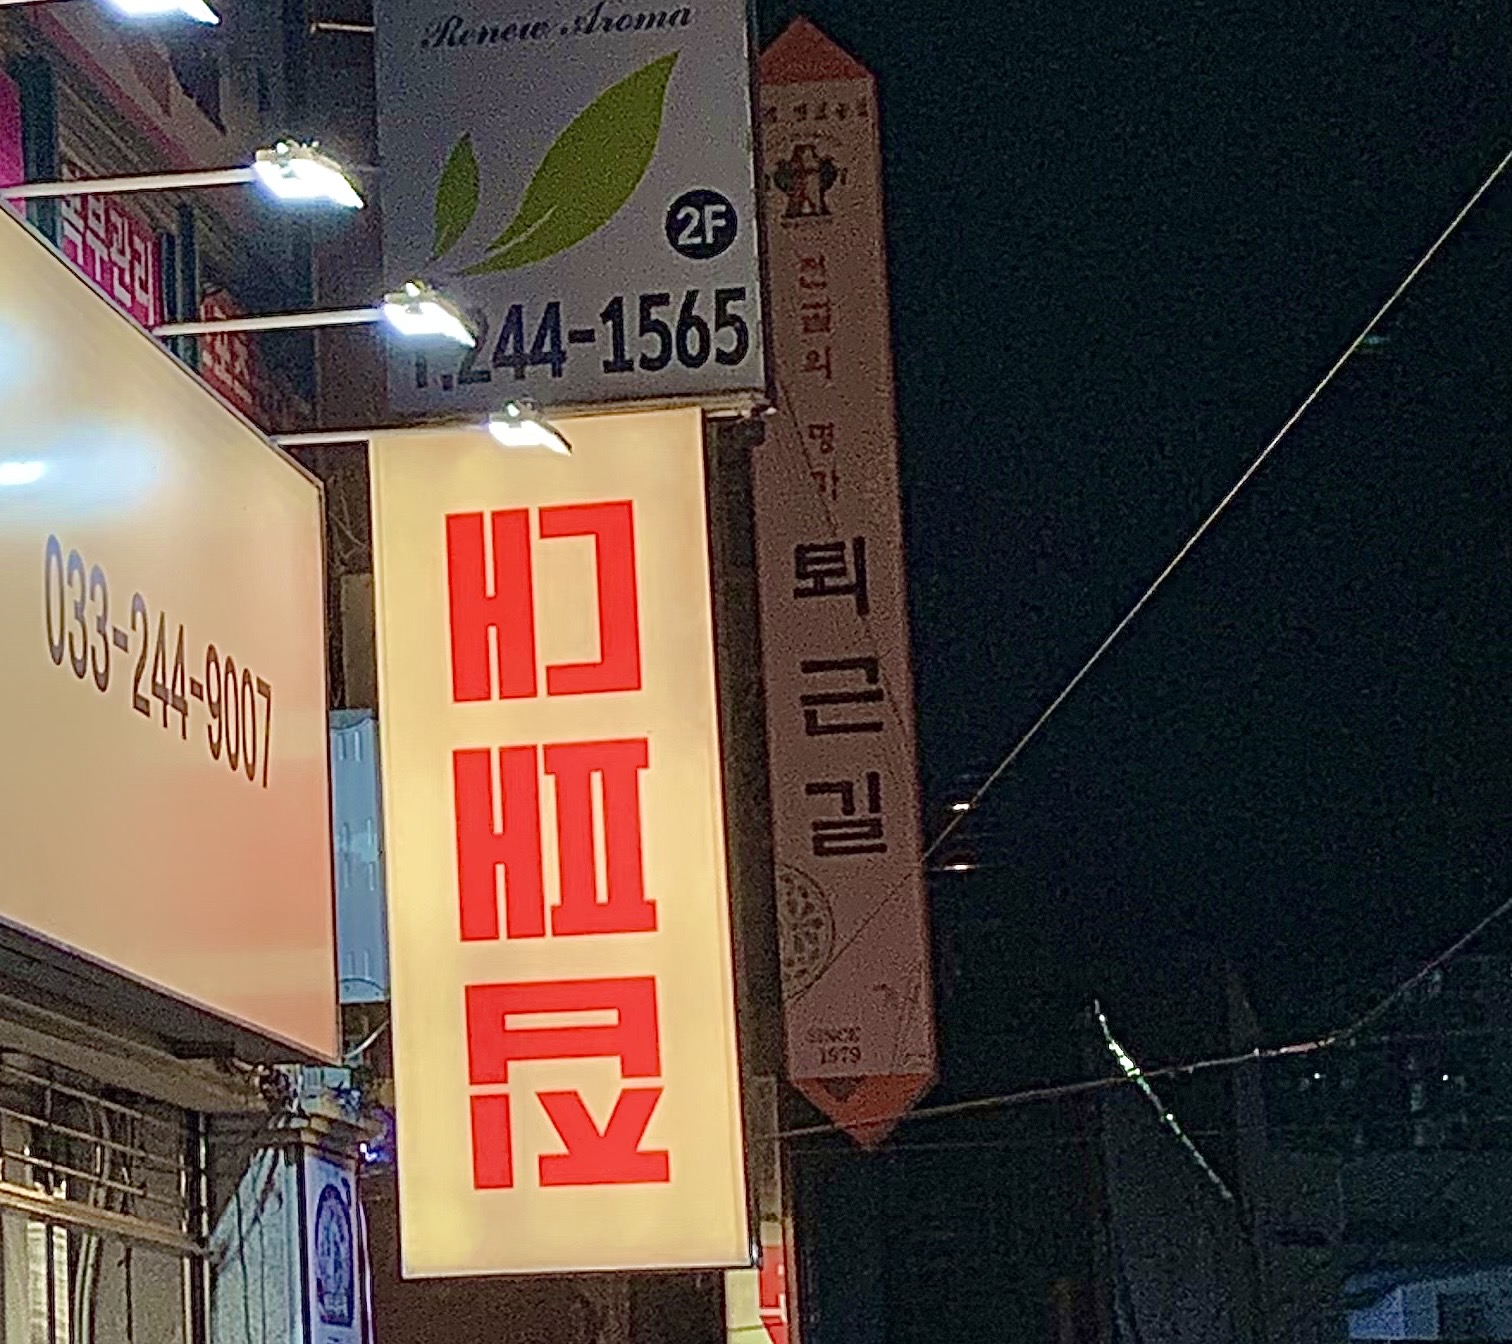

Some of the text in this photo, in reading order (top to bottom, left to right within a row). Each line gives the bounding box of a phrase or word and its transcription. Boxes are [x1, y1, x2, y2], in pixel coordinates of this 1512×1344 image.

[420, 0, 694, 49] Renew Aroma
[675, 202, 729, 248] 2F
[414, 287, 750, 391] .244-1565
[45, 533, 272, 790] 033-244-9007
[792, 535, 889, 858] 퇴근길
